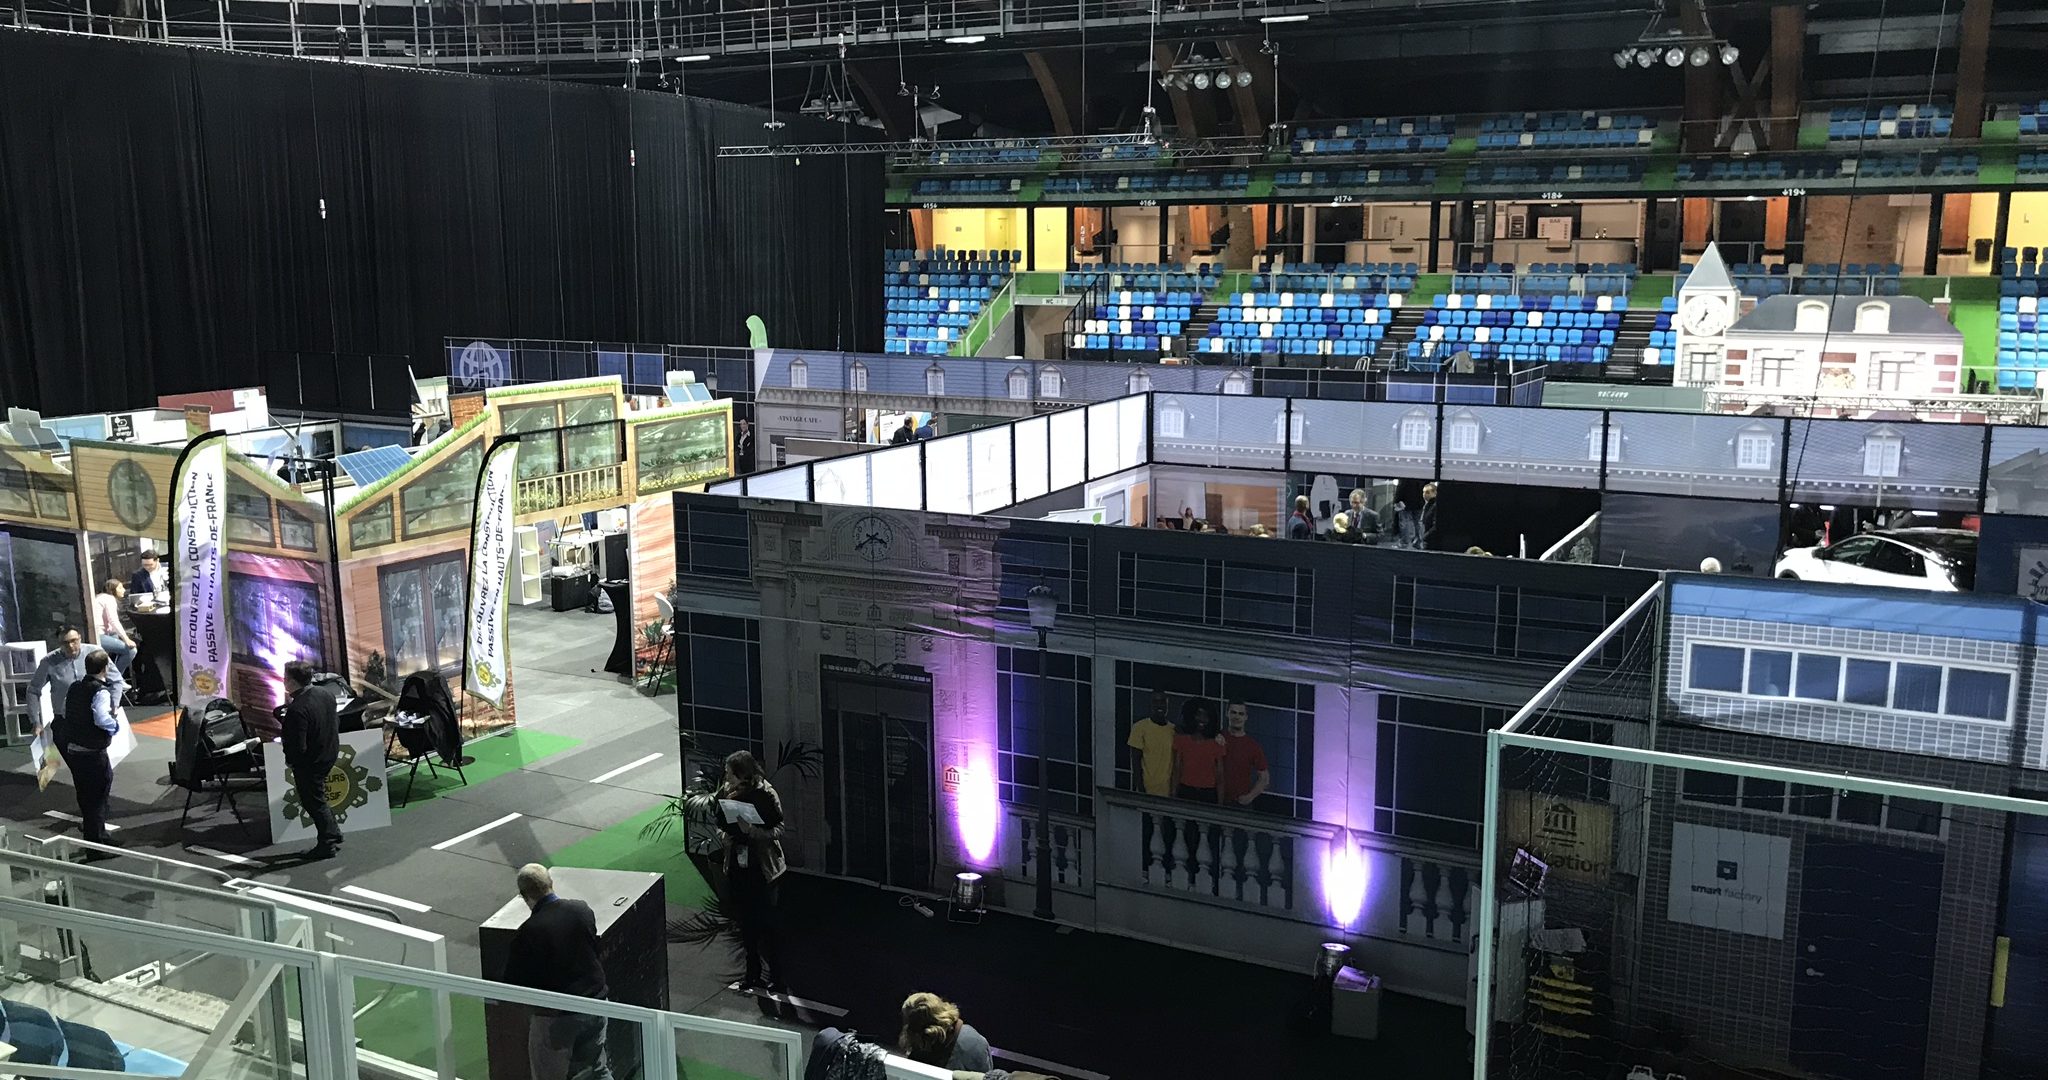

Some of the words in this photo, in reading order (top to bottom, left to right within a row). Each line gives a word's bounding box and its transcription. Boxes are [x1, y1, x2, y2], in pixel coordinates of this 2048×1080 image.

[1338, 195, 1348, 203] 17
[1547, 191, 1557, 200] 18
[1788, 188, 1800, 197] 19
[926, 202, 934, 210] 15
[1143, 199, 1152, 207] 16
[191, 564, 201, 579] LA
[481, 560, 489, 575] LA
[207, 591, 214, 609] EN
[189, 582, 201, 654] DECOUVREZ
[205, 612, 218, 663] PASSIVE
[487, 606, 496, 658] PASSIVE
[1691, 884, 1722, 896] smart
[1724, 888, 1763, 905] factory
